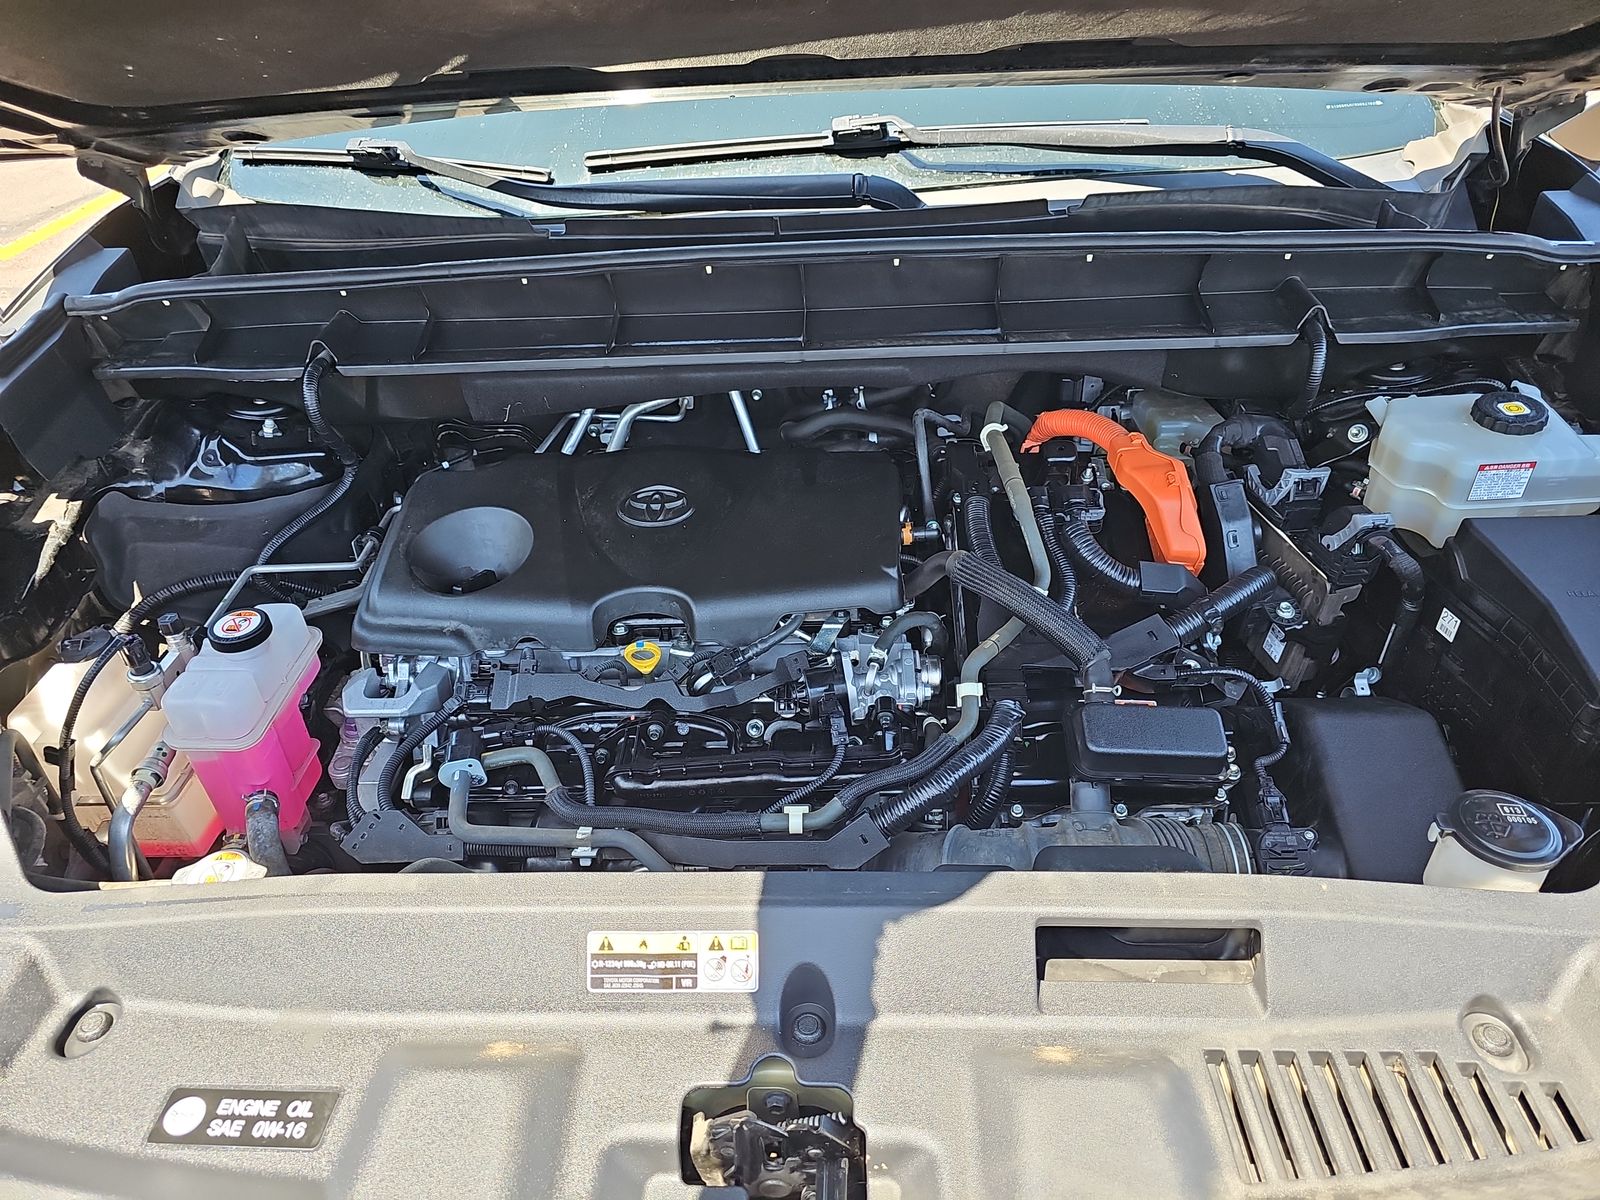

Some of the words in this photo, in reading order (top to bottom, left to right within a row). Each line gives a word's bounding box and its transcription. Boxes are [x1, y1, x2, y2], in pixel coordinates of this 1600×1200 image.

[1441, 610, 1459, 630] 271
[216, 1098, 282, 1118] ENGINE
[286, 1100, 314, 1118] OIL
[206, 1119, 246, 1137] SAE
[251, 1120, 308, 1140] 0W-16
